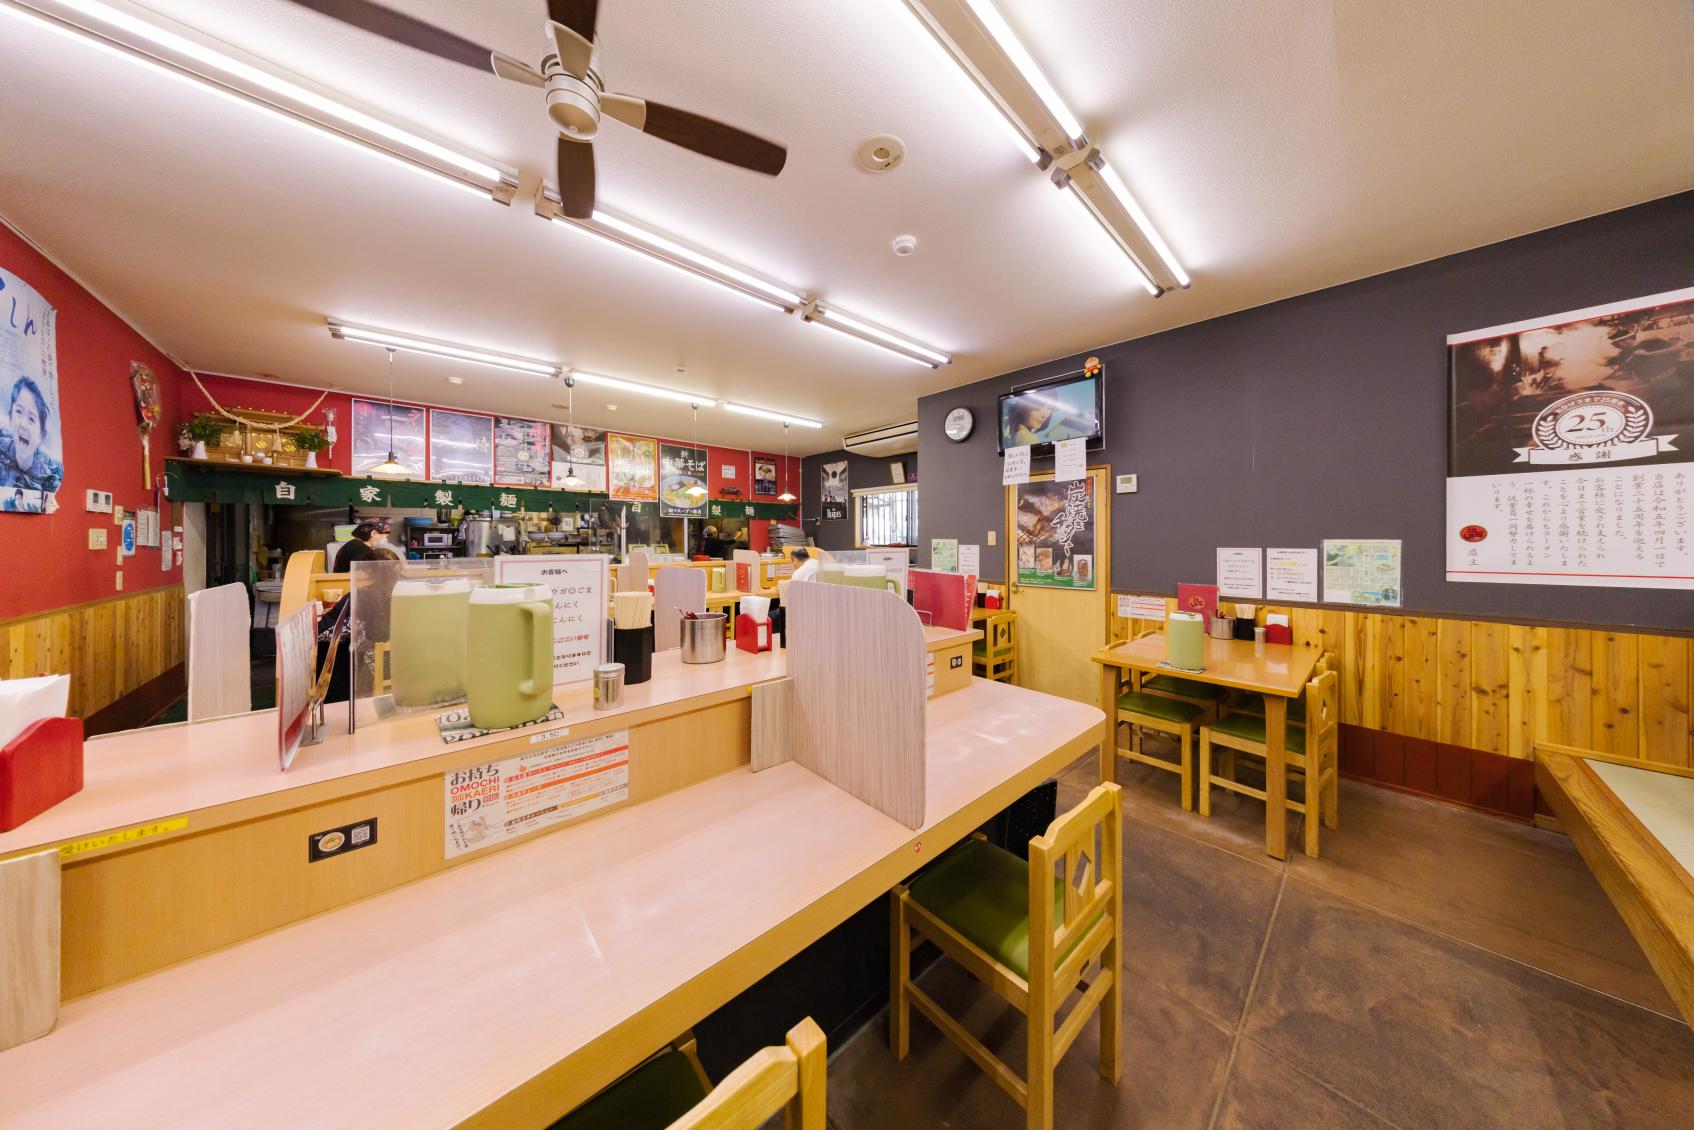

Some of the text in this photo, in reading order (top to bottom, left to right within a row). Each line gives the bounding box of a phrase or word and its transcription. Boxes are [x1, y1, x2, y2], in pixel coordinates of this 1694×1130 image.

[1568, 450, 1611, 462] 感謝
[274, 481, 518, 508] 自家製麺
[1614, 476, 1628, 540] ことになりました。
[1674, 472, 1689, 556] ありがとうございます。
[450, 764, 499, 786] お持ち
[450, 776, 500, 795] OMOCHI
[465, 784, 500, 800] KAERI
[450, 798, 482, 817] 帰り
